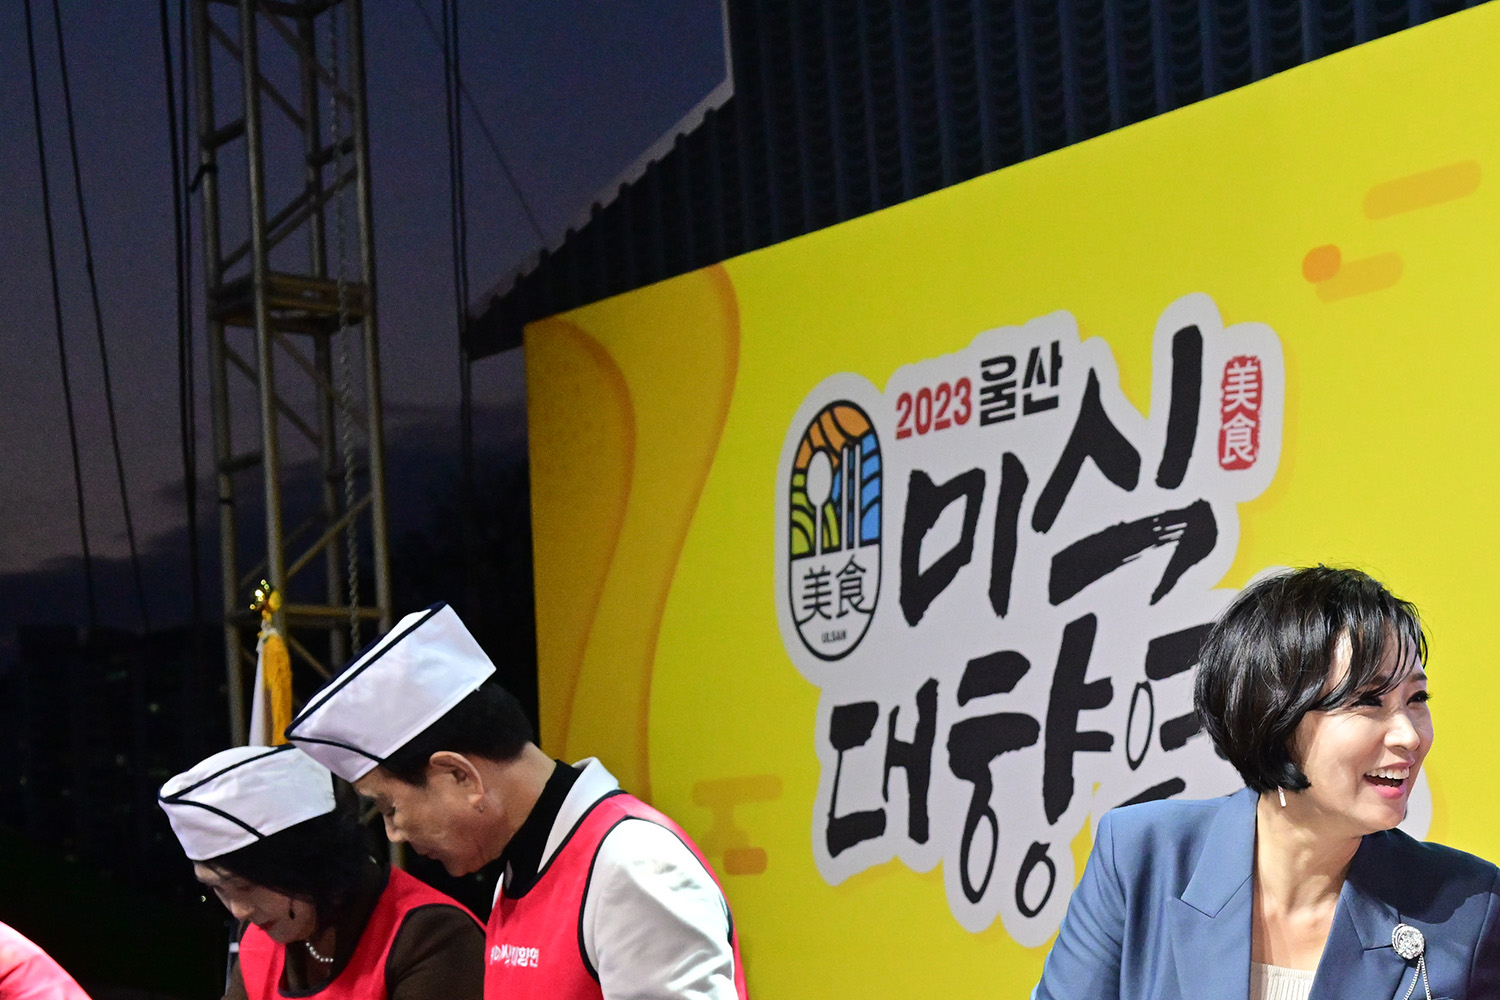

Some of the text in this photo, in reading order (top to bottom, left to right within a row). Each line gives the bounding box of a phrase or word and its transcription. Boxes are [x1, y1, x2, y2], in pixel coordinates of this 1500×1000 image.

[895, 340, 1063, 440] 2023 울산
[1218, 356, 1263, 470] 美食
[899, 324, 1218, 627] 미식
[798, 554, 872, 625] 美食
